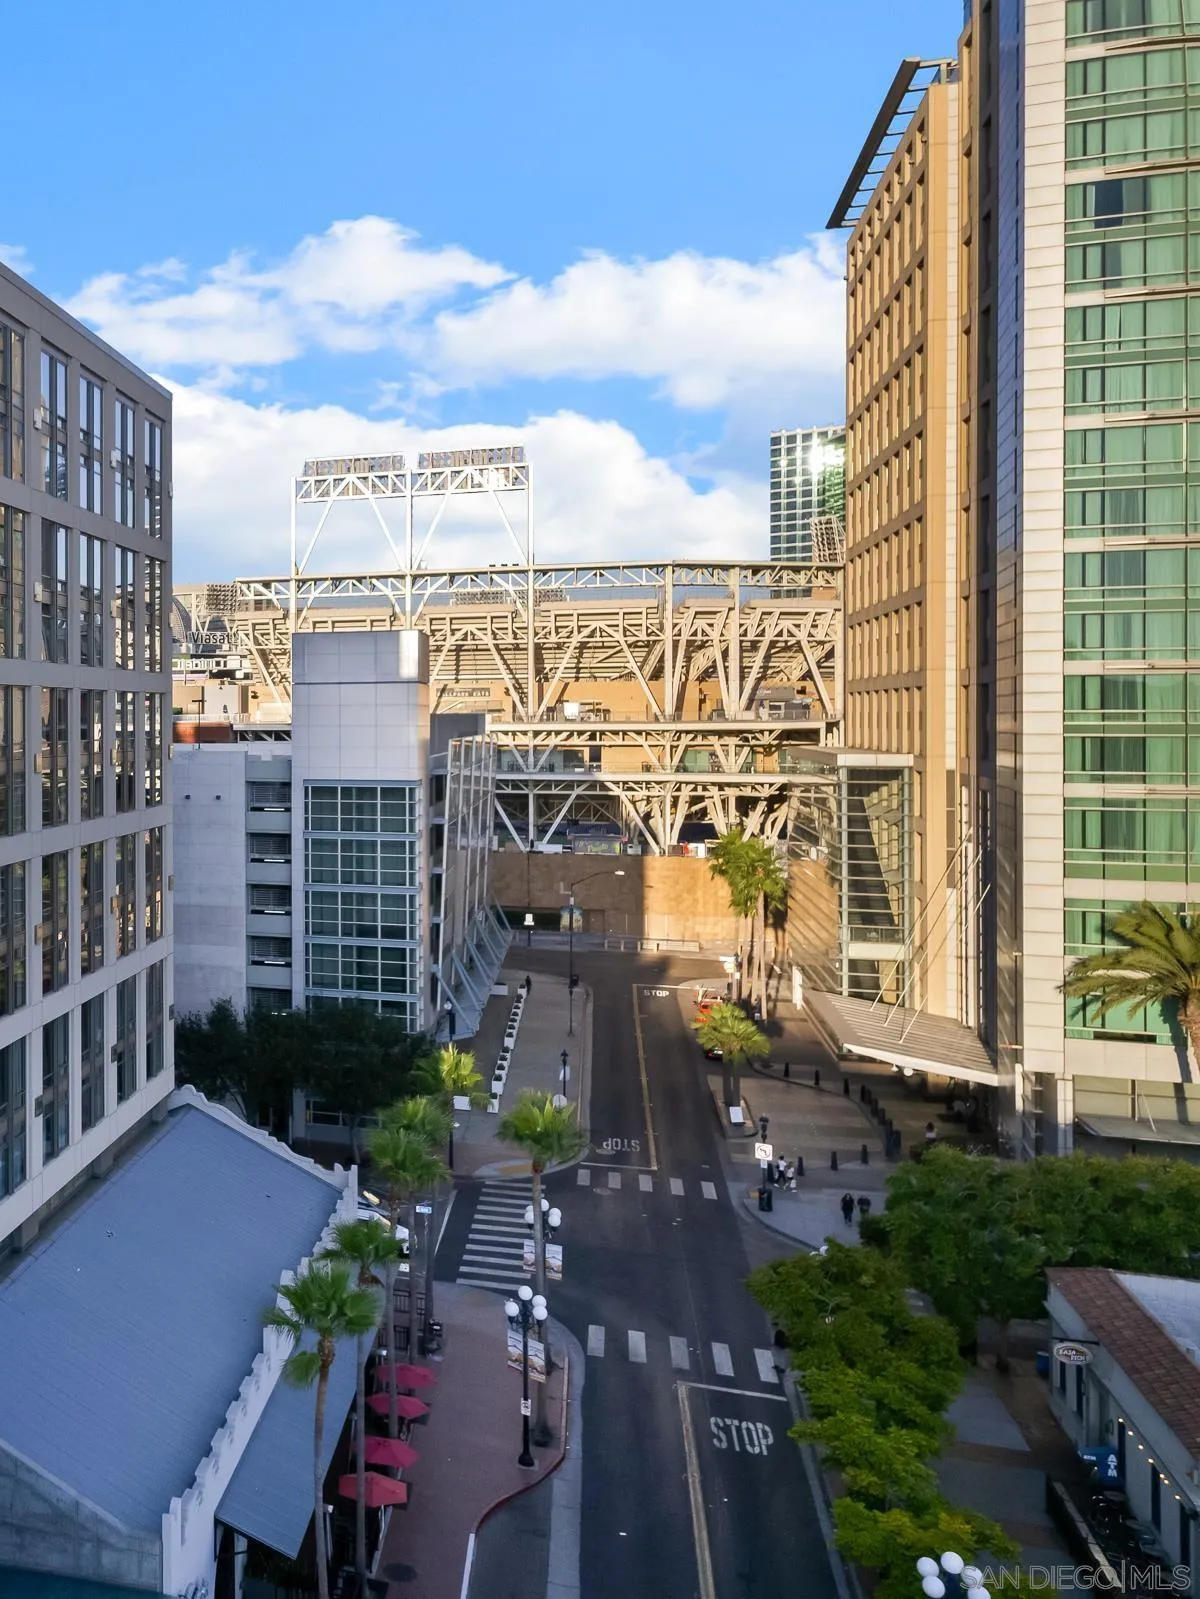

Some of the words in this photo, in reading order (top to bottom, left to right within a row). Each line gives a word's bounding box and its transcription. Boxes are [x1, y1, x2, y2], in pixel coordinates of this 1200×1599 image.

[191, 631, 232, 644] Viasat
[643, 989, 670, 998] STOP
[602, 1137, 641, 1152] STOP
[709, 1416, 775, 1456] STOP
[1107, 1454, 1118, 1478] ATM
